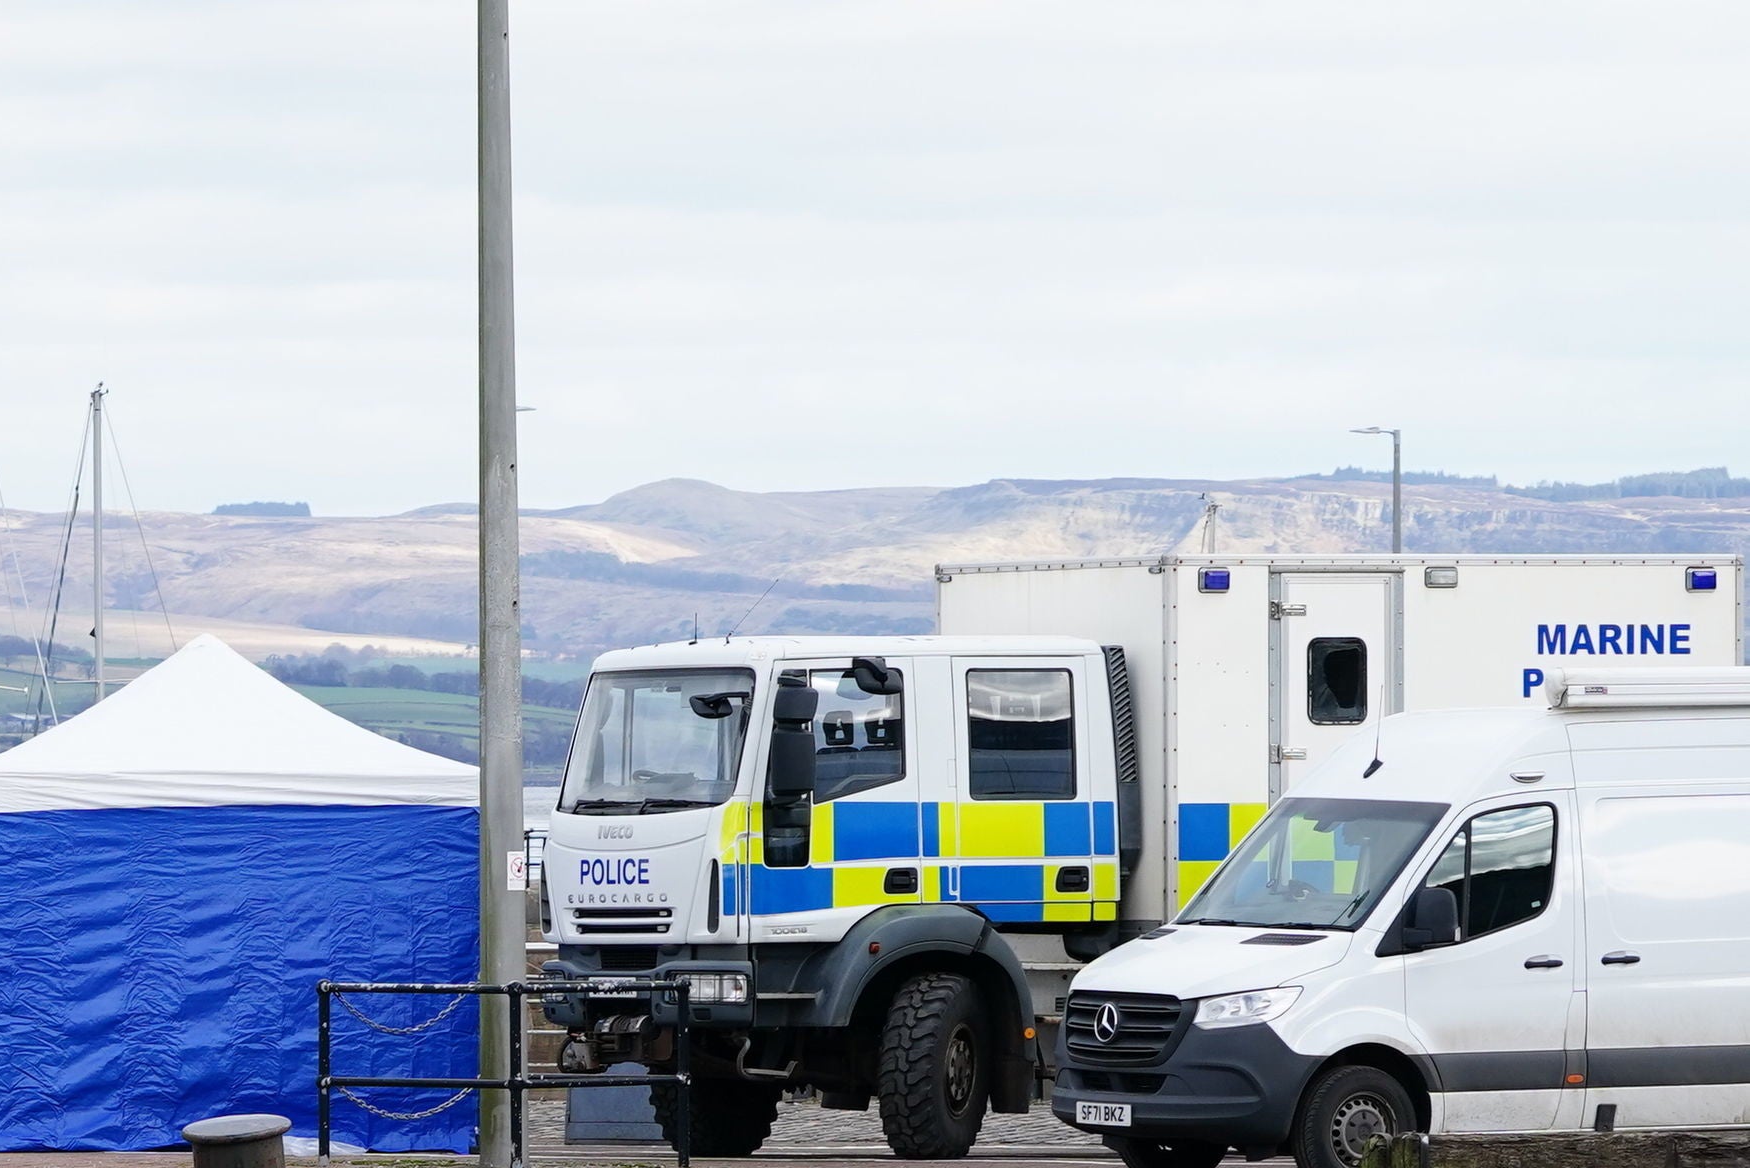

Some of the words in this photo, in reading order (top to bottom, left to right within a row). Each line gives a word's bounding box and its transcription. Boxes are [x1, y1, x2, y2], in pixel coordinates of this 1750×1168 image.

[1537, 624, 1691, 655] MARINE
[598, 825, 634, 839] IVECO
[580, 858, 650, 885] POLICE
[567, 893, 668, 903] EUROCARGO
[1082, 1105, 1101, 1120] SF71
[1104, 1106, 1124, 1122] BKZ
